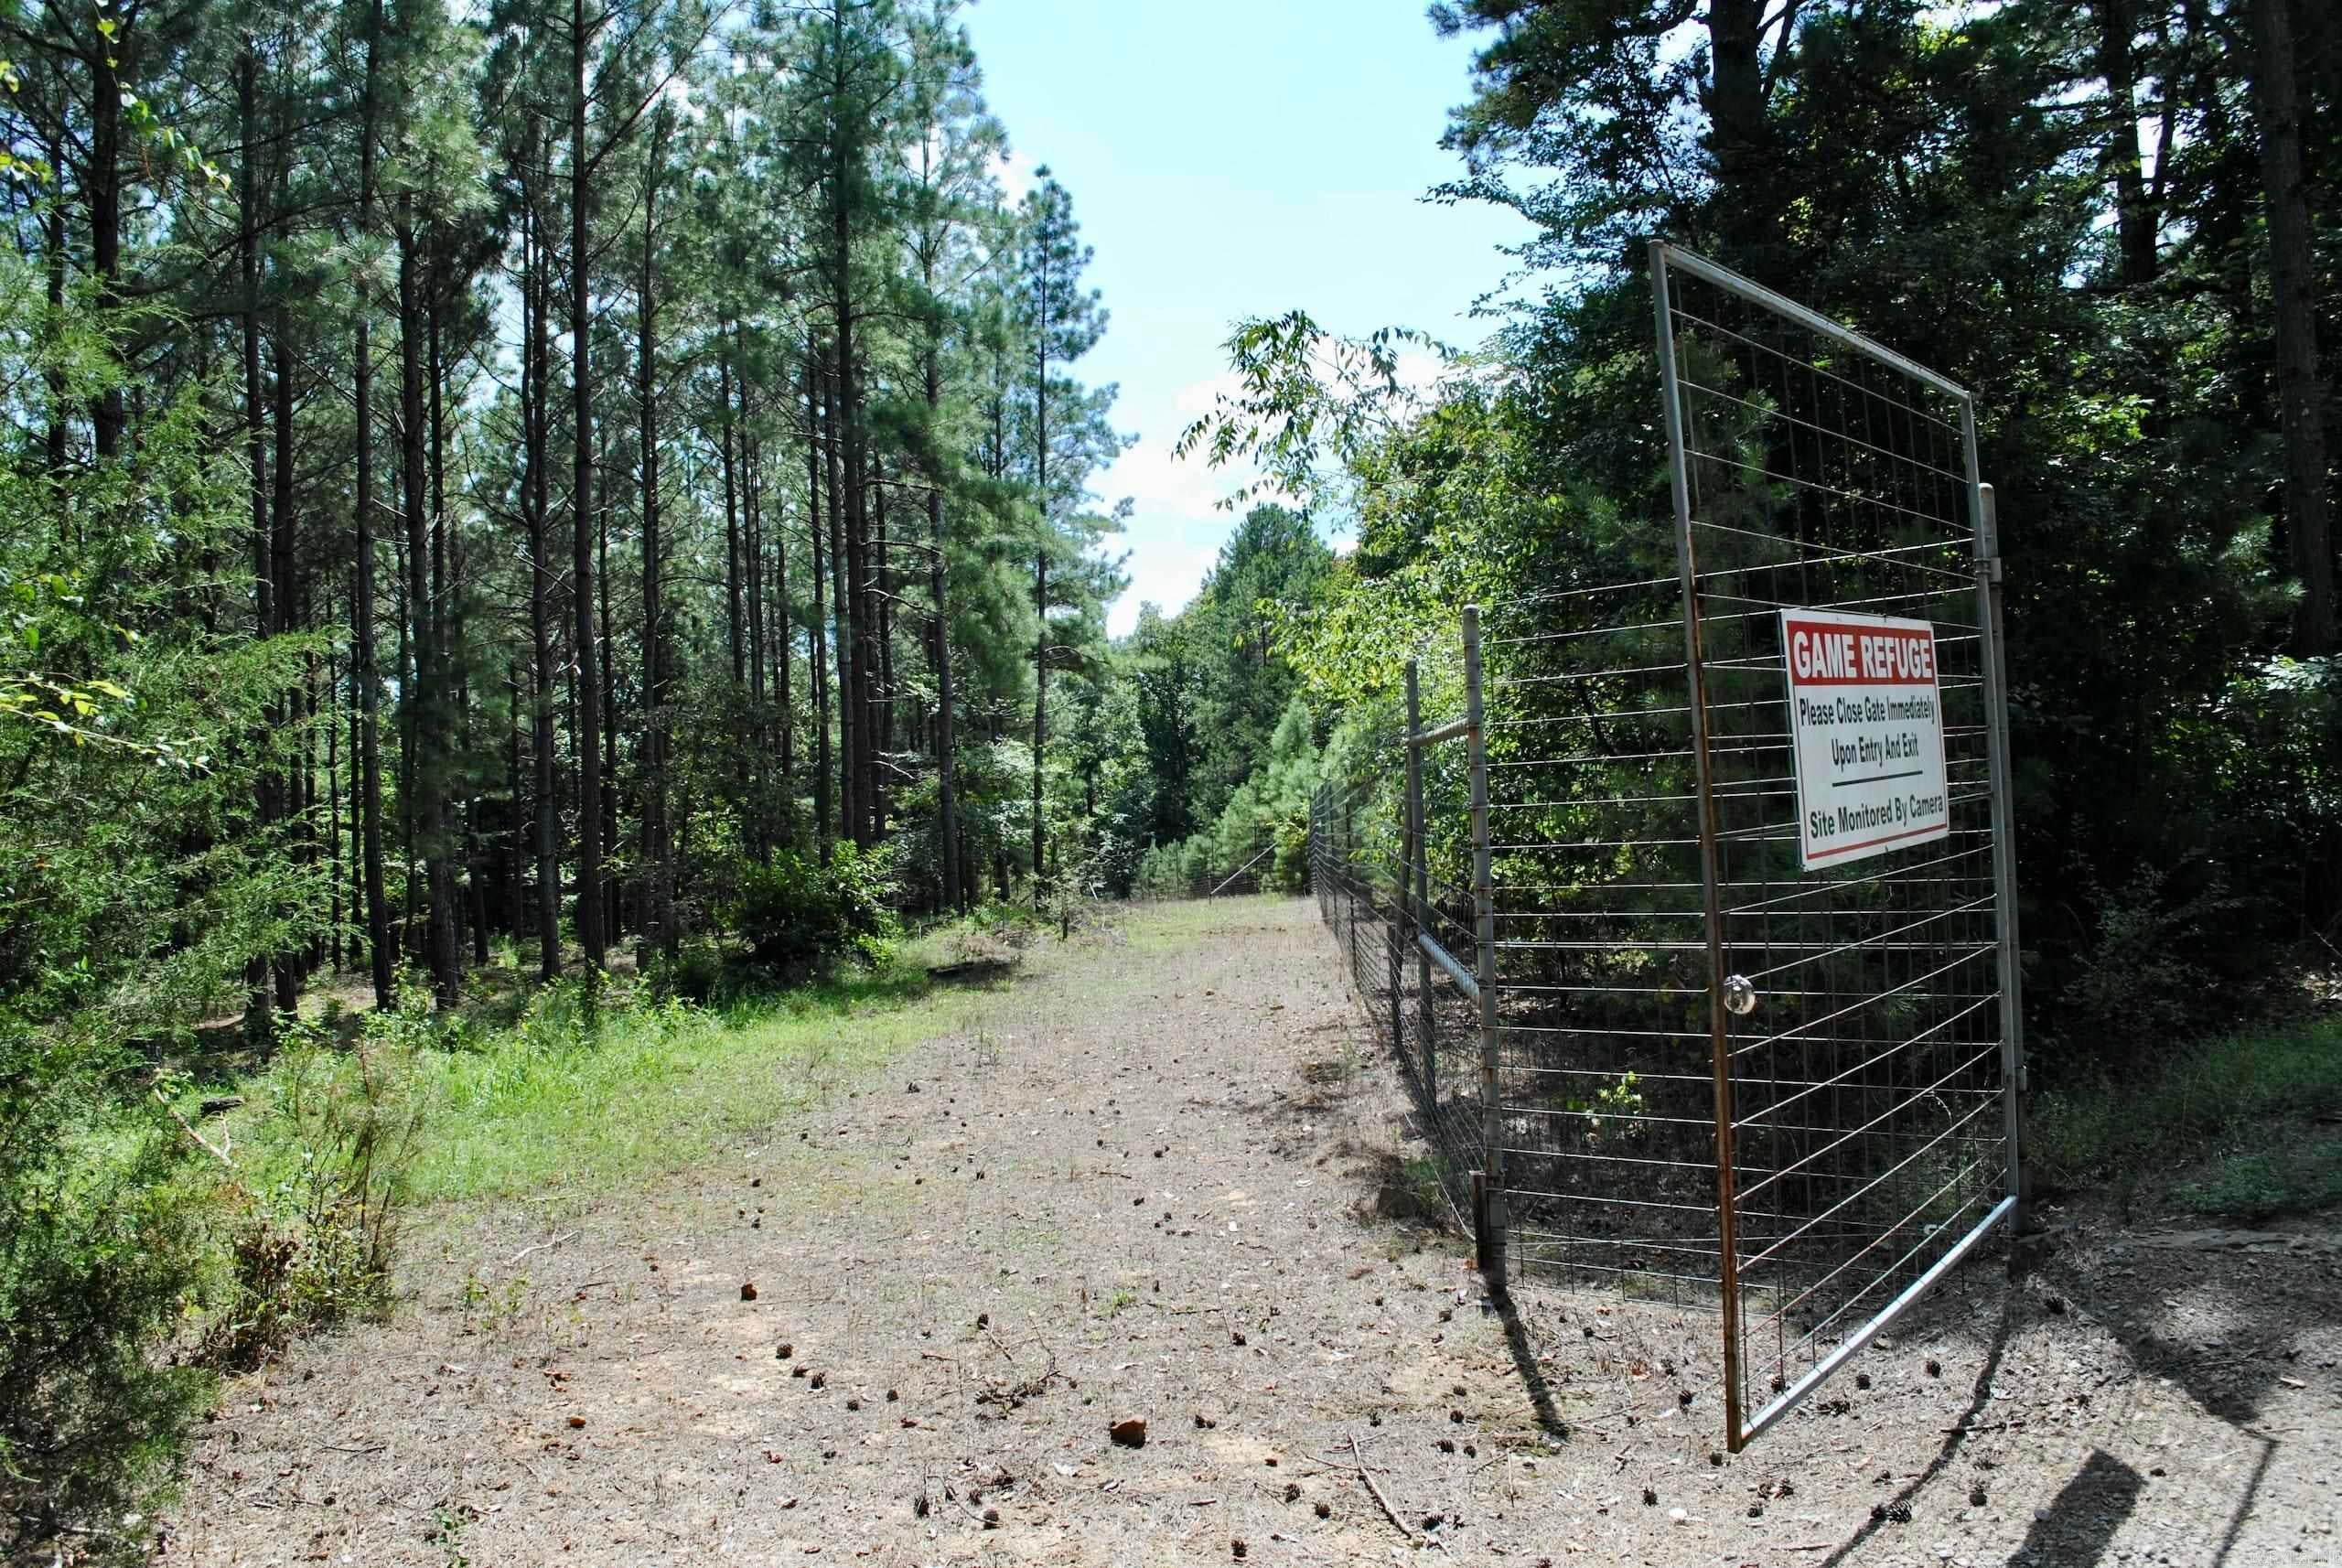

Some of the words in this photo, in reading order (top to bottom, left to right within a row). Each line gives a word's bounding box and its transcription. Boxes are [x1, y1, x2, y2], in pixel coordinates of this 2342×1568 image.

[1793, 631, 1857, 679] GAME
[1860, 635, 1932, 679] REFUGE
[1799, 697, 1834, 726] Please
[1836, 696, 1863, 725] Close
[1864, 696, 1885, 723] Gate
[1887, 694, 1935, 725] Immediately
[1832, 738, 1857, 772] Upon
[1859, 736, 1884, 768] Entry
[1885, 734, 1901, 760] And
[1902, 732, 1918, 757] Exit
[1810, 811, 1835, 839] Site
[1838, 798, 1893, 833] Monitored
[1895, 797, 1907, 827] By
[1909, 794, 1943, 819] Camera
